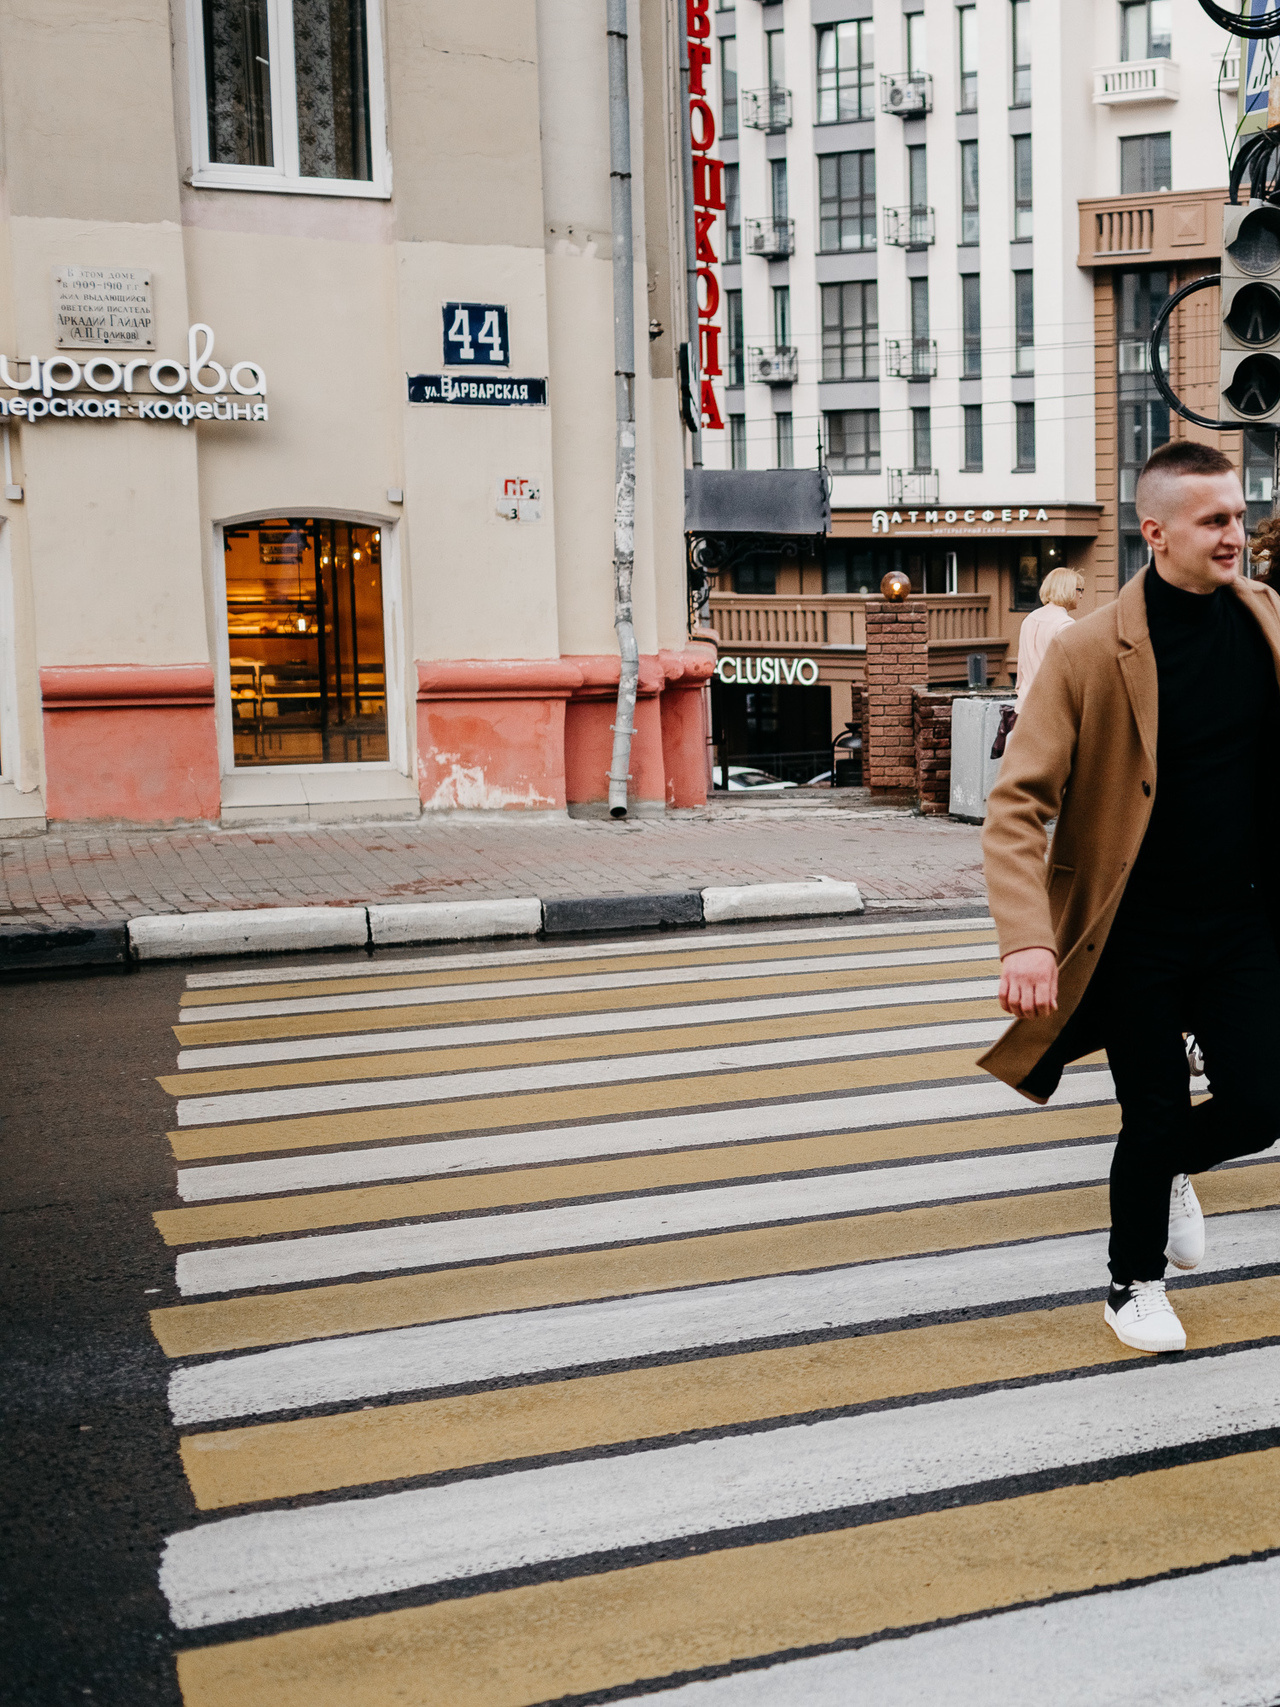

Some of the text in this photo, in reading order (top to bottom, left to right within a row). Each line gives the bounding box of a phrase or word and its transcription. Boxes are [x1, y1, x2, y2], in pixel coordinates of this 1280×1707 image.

[57, 313, 151, 328] АРКАДИЙ ГАЙДАР
[106, 305, 151, 314] ПИСАТЕЛЬ
[448, 309, 504, 361] 44
[138, 395, 269, 426] кофейня
[714, 656, 819, 686] CLUSIVO
